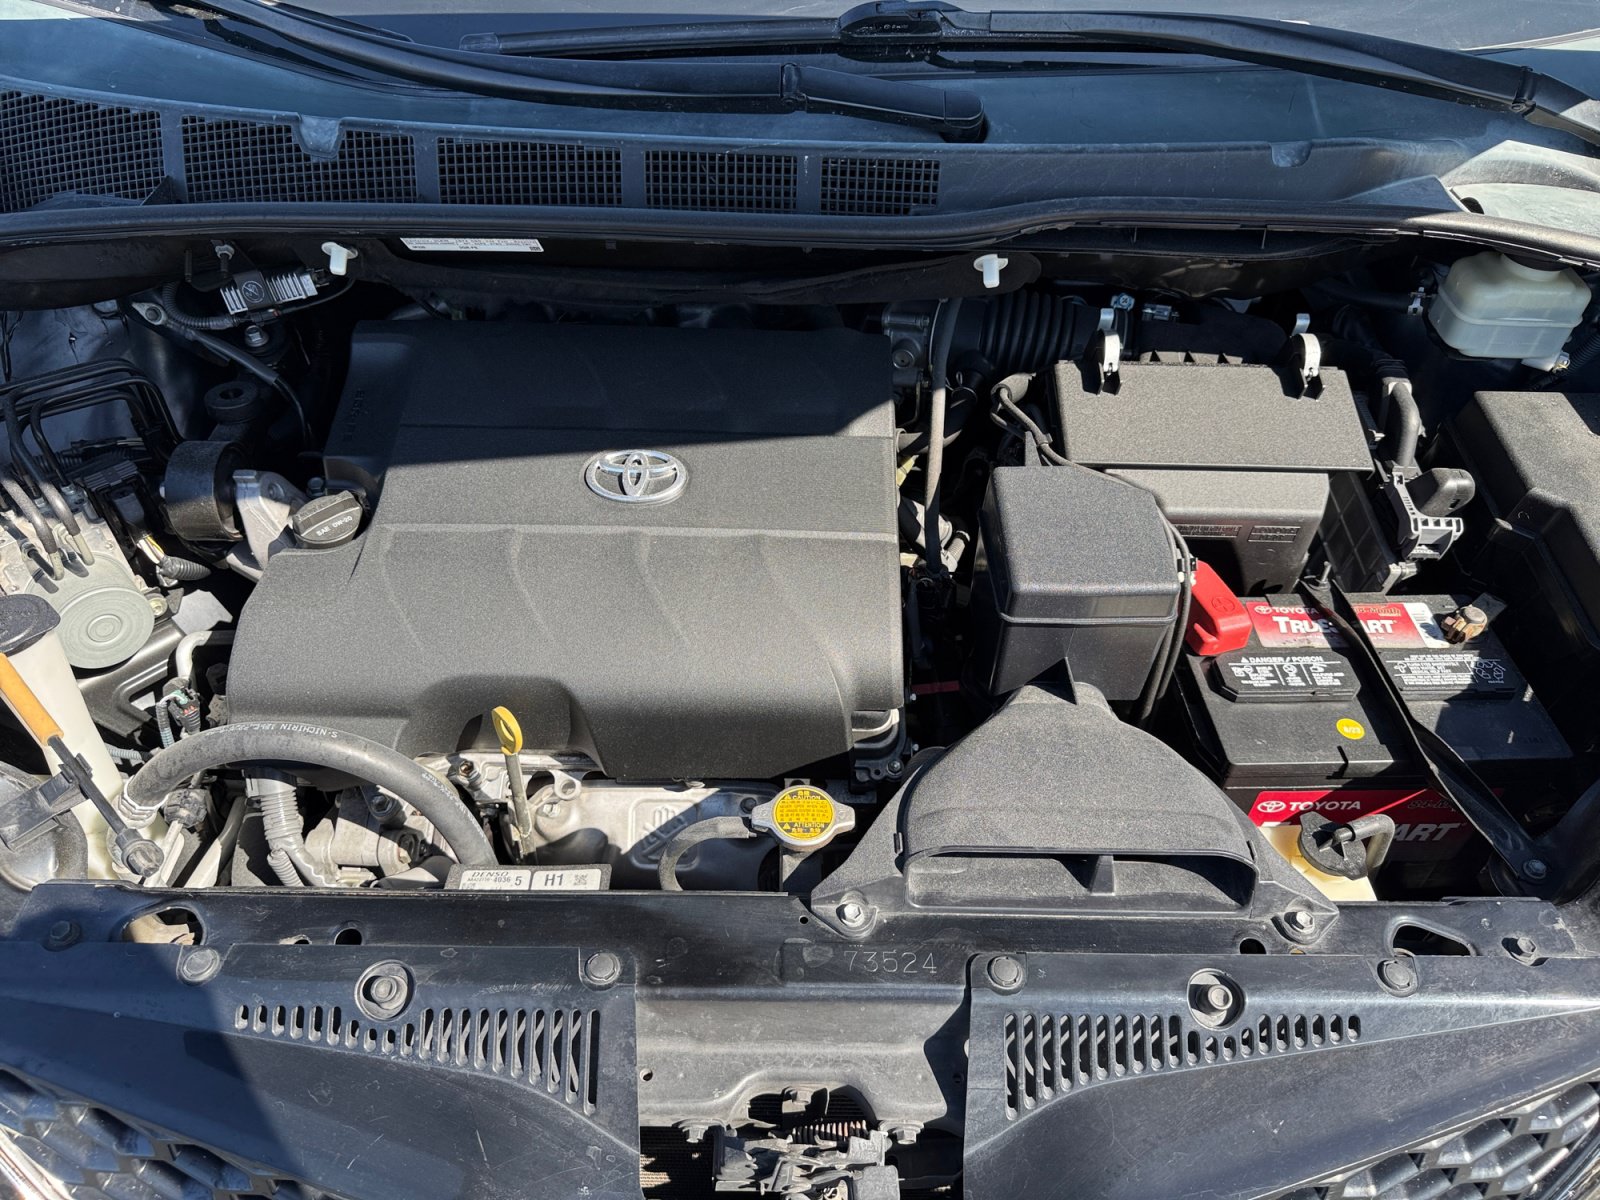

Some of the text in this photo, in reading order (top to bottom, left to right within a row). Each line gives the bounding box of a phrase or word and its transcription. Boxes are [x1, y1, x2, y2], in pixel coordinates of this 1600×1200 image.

[316, 526, 331, 536] SAE
[1272, 606, 1319, 614] TOYOTA
[1289, 800, 1361, 810] TOYOTA
[514, 877, 522, 886] 5
[544, 874, 564, 887] H1
[843, 950, 937, 974] 73524
